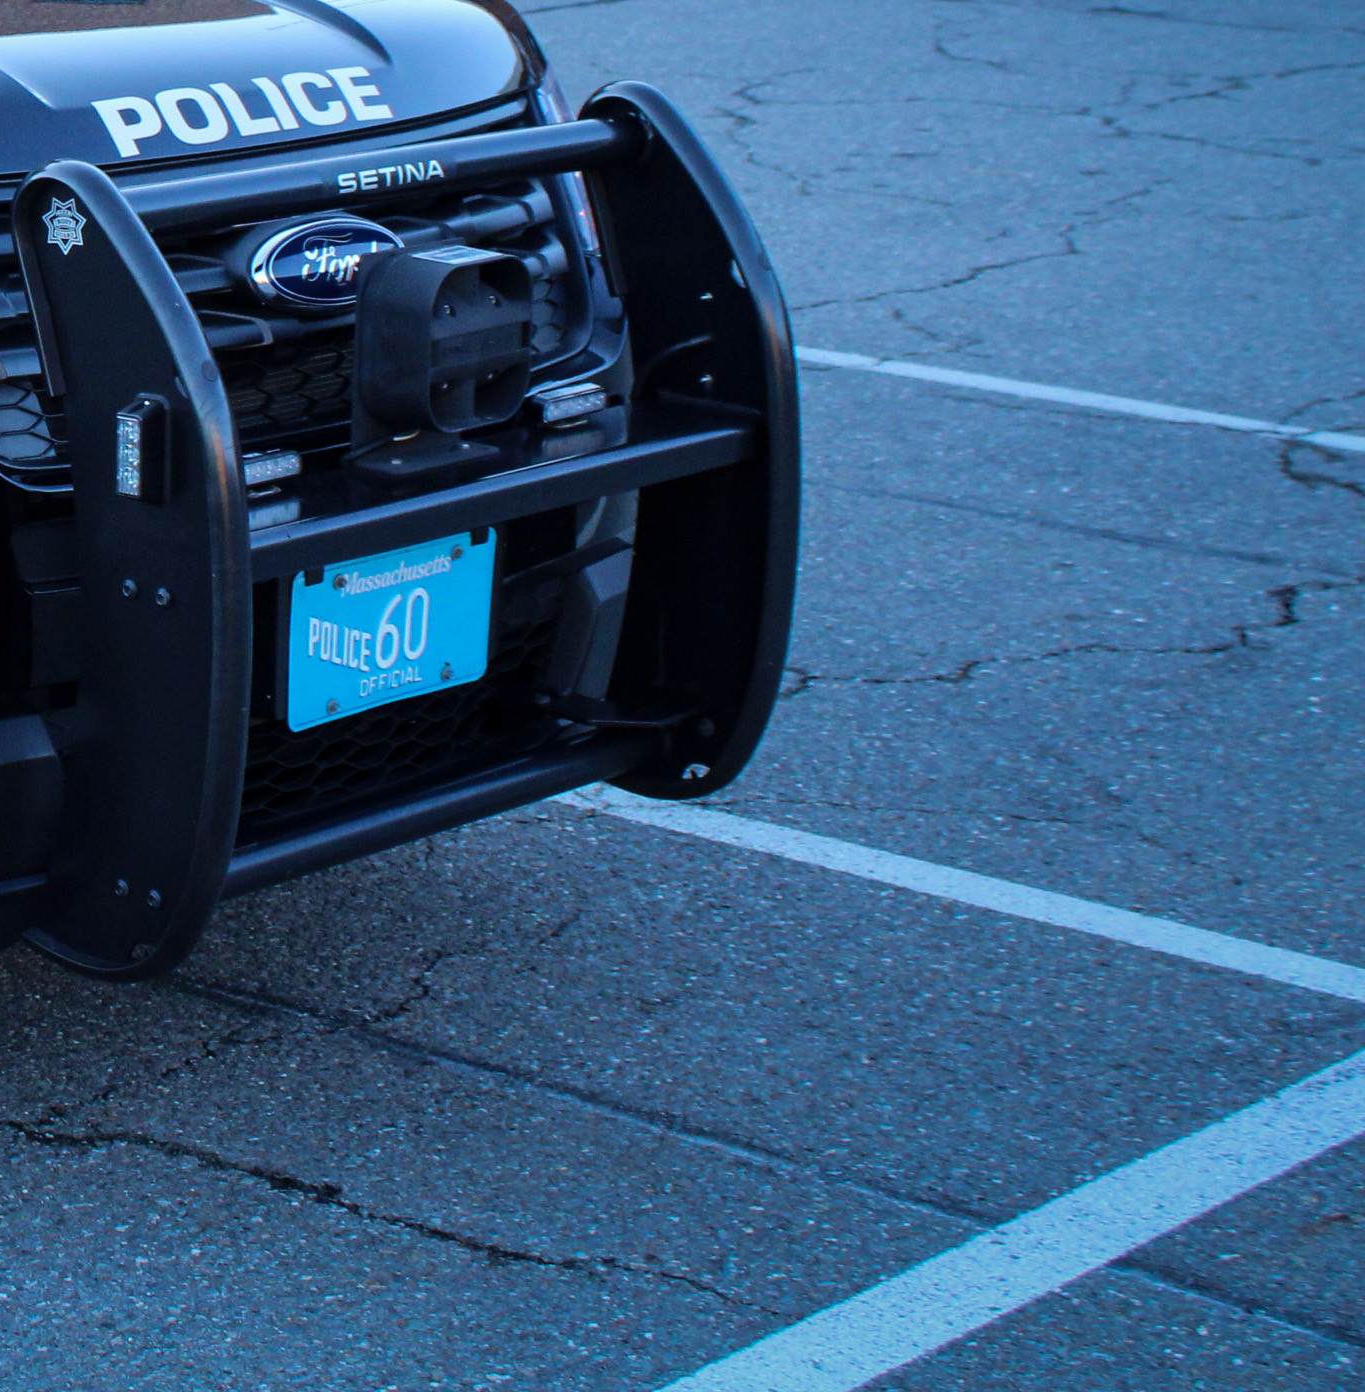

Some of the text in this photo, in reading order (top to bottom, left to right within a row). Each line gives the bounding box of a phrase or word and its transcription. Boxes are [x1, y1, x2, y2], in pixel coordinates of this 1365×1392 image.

[90, 65, 394, 158] POLICE
[337, 159, 445, 194] SETINA
[341, 555, 452, 597] Massachusetts
[308, 587, 430, 672] POLICE 60
[359, 665, 423, 698] OFFICIAL
